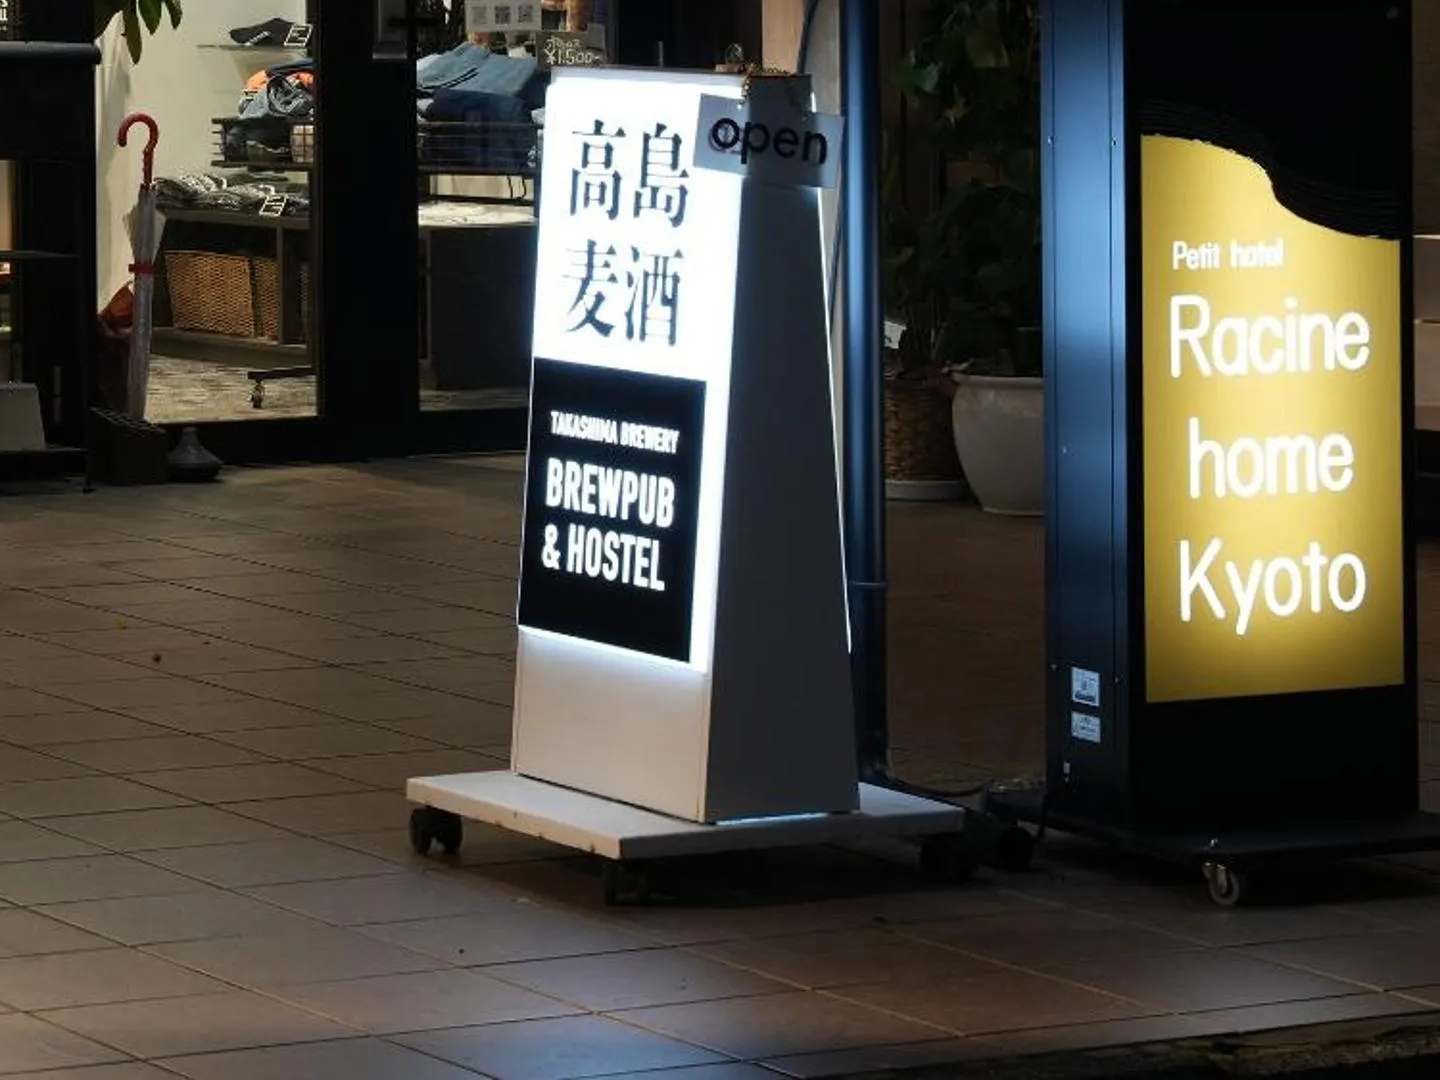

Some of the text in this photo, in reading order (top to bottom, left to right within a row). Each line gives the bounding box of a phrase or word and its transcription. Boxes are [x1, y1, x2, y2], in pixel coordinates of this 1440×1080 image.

[570, 118, 690, 228] 高島
[710, 118, 828, 165] open
[1172, 235, 1284, 271] Petit hotel
[562, 238, 684, 347] 麦酒
[1169, 294, 1371, 378] Racine
[550, 410, 680, 454] TAKASHIMA BREWERY
[1189, 416, 1354, 499] home
[545, 457, 675, 529] BREWPUB
[541, 522, 666, 591] & HOSTEL
[1179, 537, 1366, 636] Kyoto
